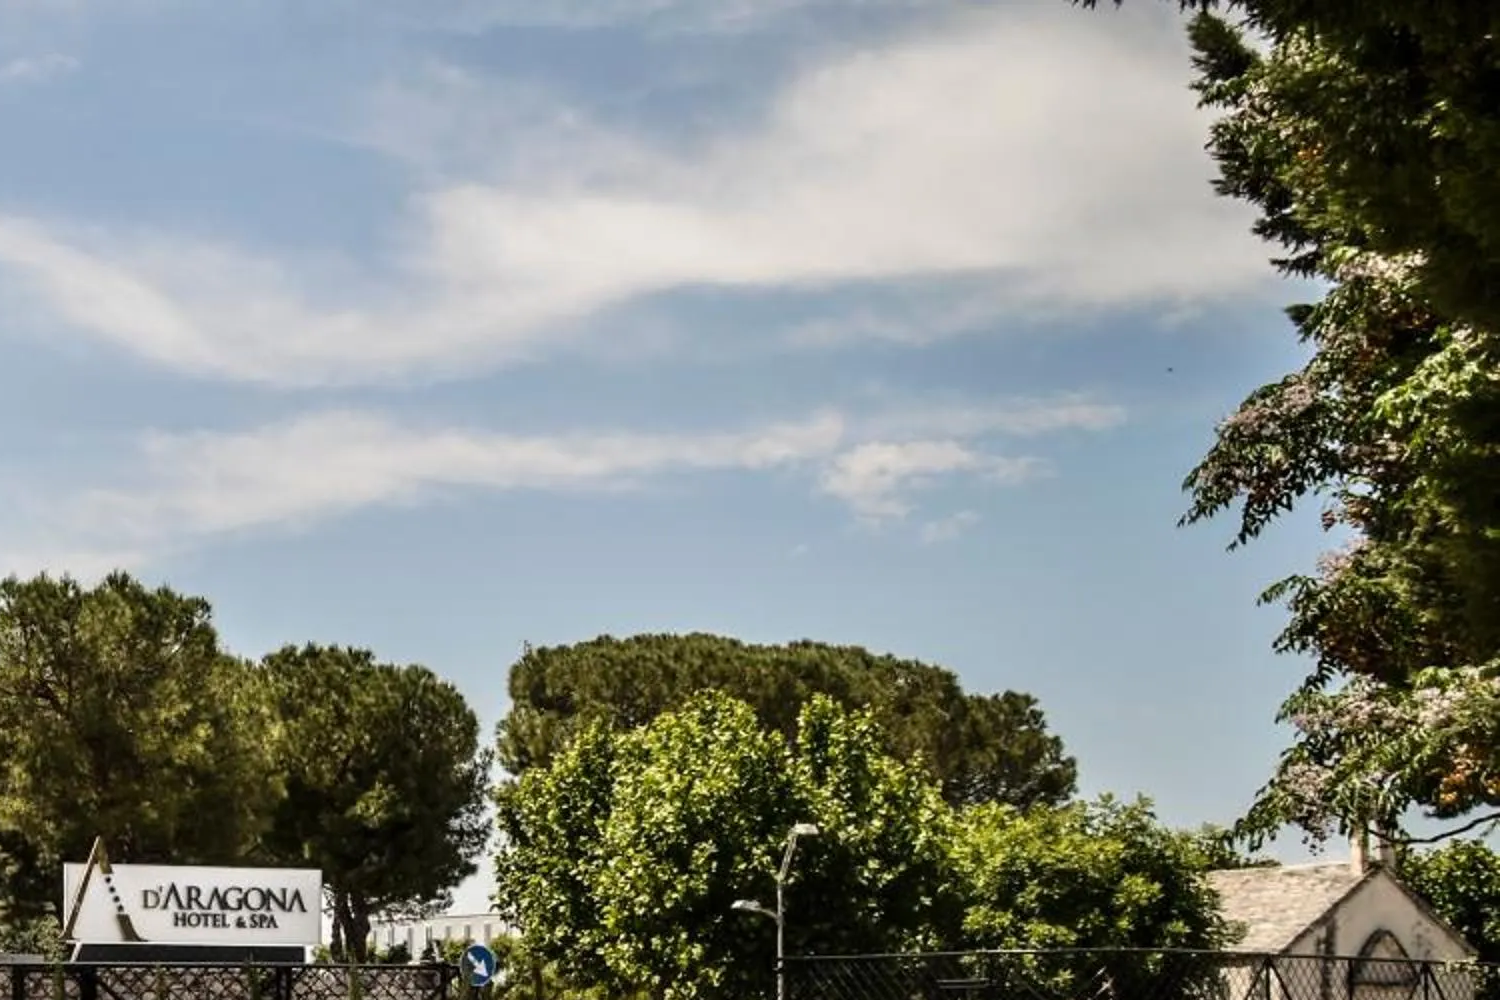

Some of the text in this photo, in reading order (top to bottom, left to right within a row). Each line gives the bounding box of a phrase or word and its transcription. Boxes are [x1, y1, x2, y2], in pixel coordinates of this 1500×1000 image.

[142, 882, 307, 912] D'ARAGONA
[173, 912, 278, 929] HOTEL & SPA
